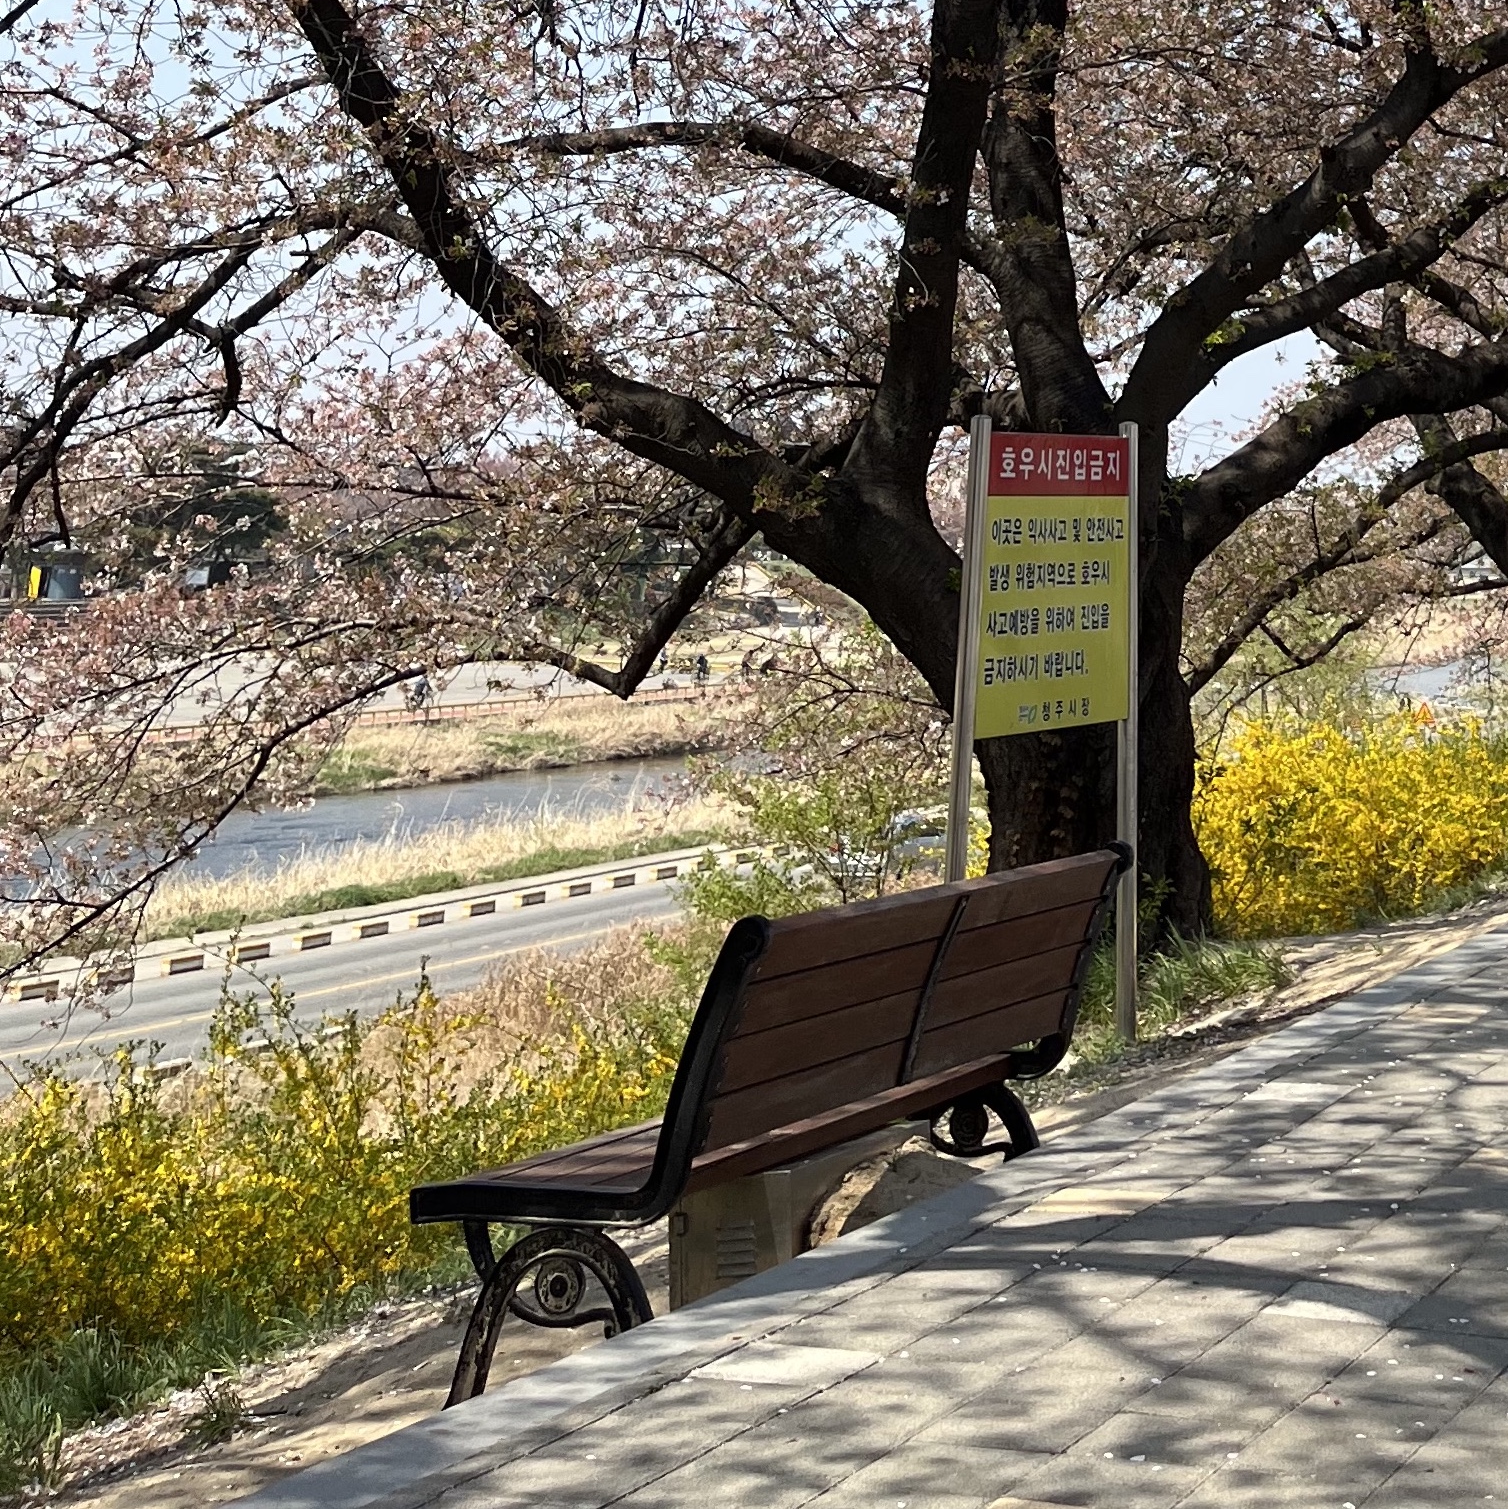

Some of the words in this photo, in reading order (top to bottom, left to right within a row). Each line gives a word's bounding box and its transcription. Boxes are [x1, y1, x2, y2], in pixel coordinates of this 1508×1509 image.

[1000, 446, 1120, 481] 호우시진입금지
[992, 518, 1022, 545] 이곳은
[1028, 518, 1067, 544] 익사사고
[1072, 517, 1082, 543] 및
[1086, 517, 1124, 542] 안전사고
[989, 563, 1011, 592] 발생
[1015, 562, 1076, 590] 위험지역으로
[1081, 560, 1110, 585] 호우시
[986, 607, 1040, 638] 사고예방을
[1045, 606, 1075, 633] 위하여
[1081, 603, 1110, 630] 진입을
[984, 654, 1039, 685] 금지하시기
[1043, 649, 1089, 678] 바랍니다.
